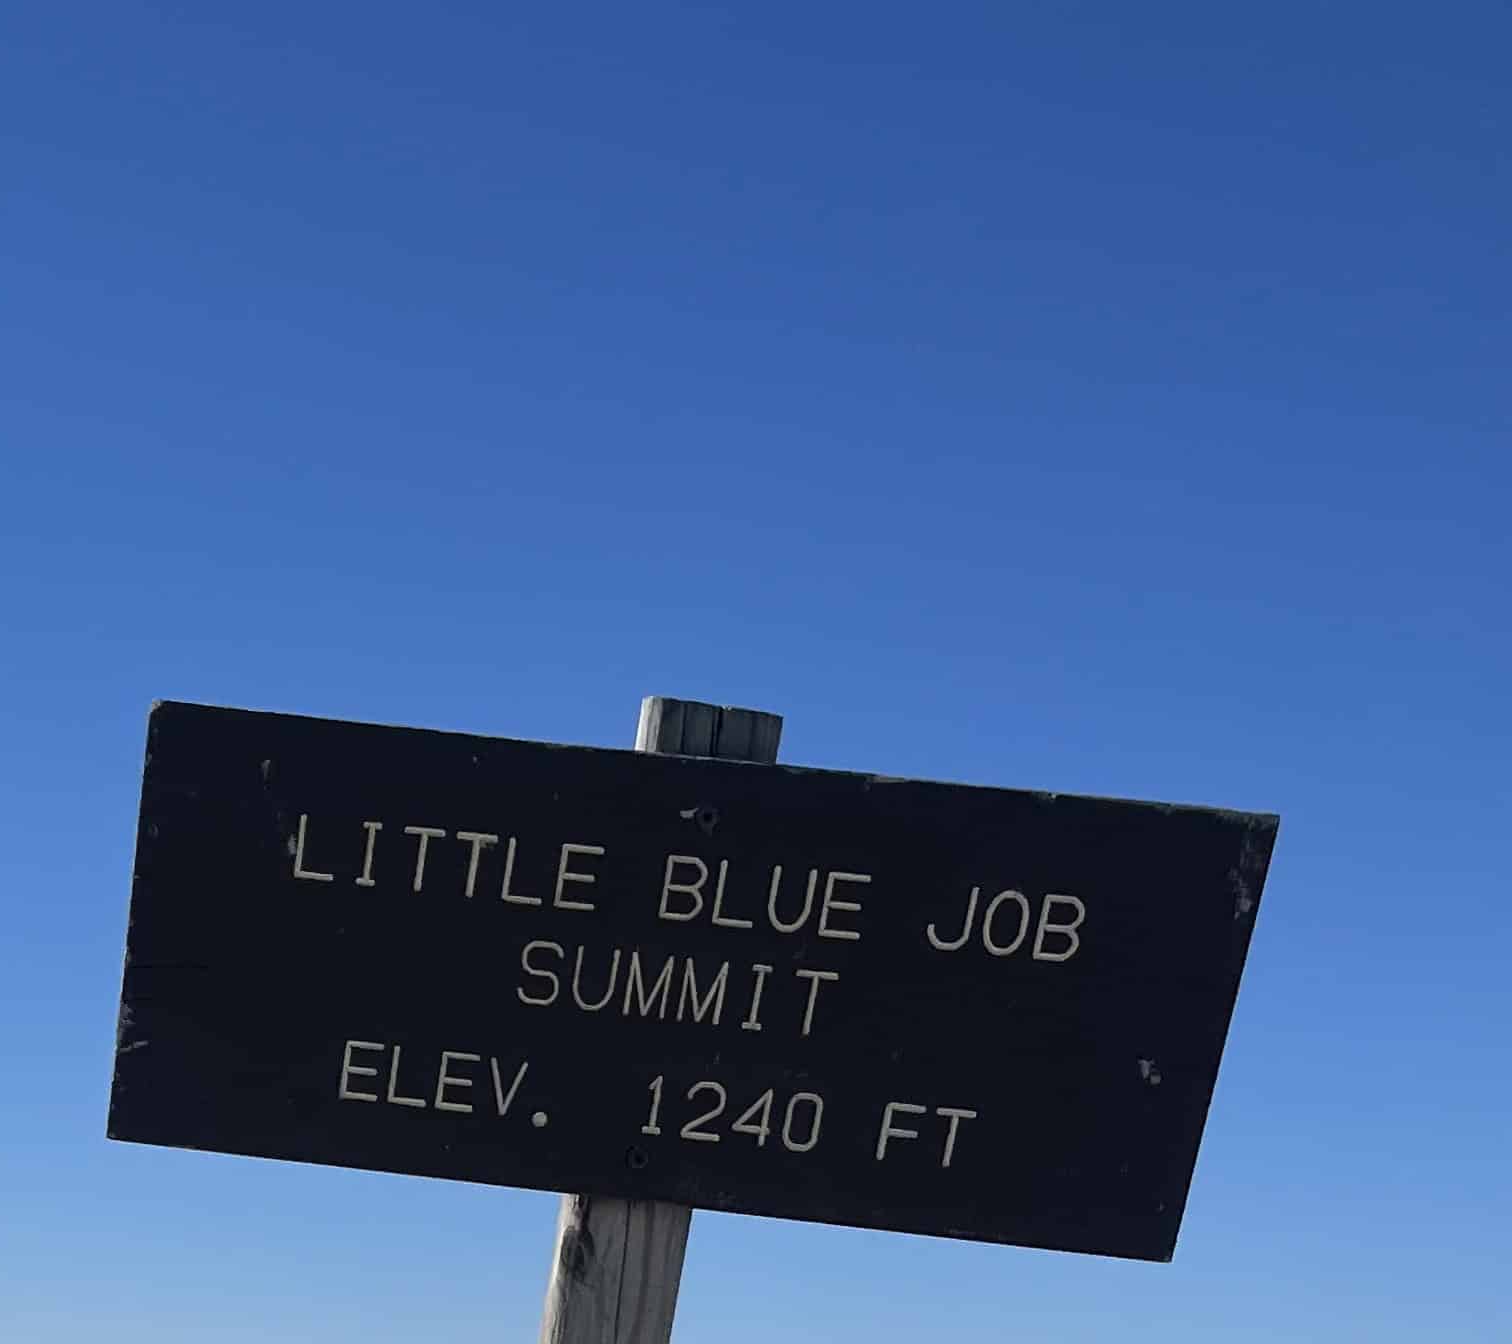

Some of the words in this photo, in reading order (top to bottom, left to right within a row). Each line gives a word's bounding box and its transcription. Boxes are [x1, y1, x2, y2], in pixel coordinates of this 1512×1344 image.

[292, 812, 606, 911] LITTLE
[658, 853, 873, 941] BLUE
[926, 885, 1087, 963] JOB
[516, 939, 840, 1036] SUMMIT
[338, 1039, 549, 1128] ELEV.
[640, 1074, 825, 1153] 1240
[875, 1101, 978, 1168] FT
